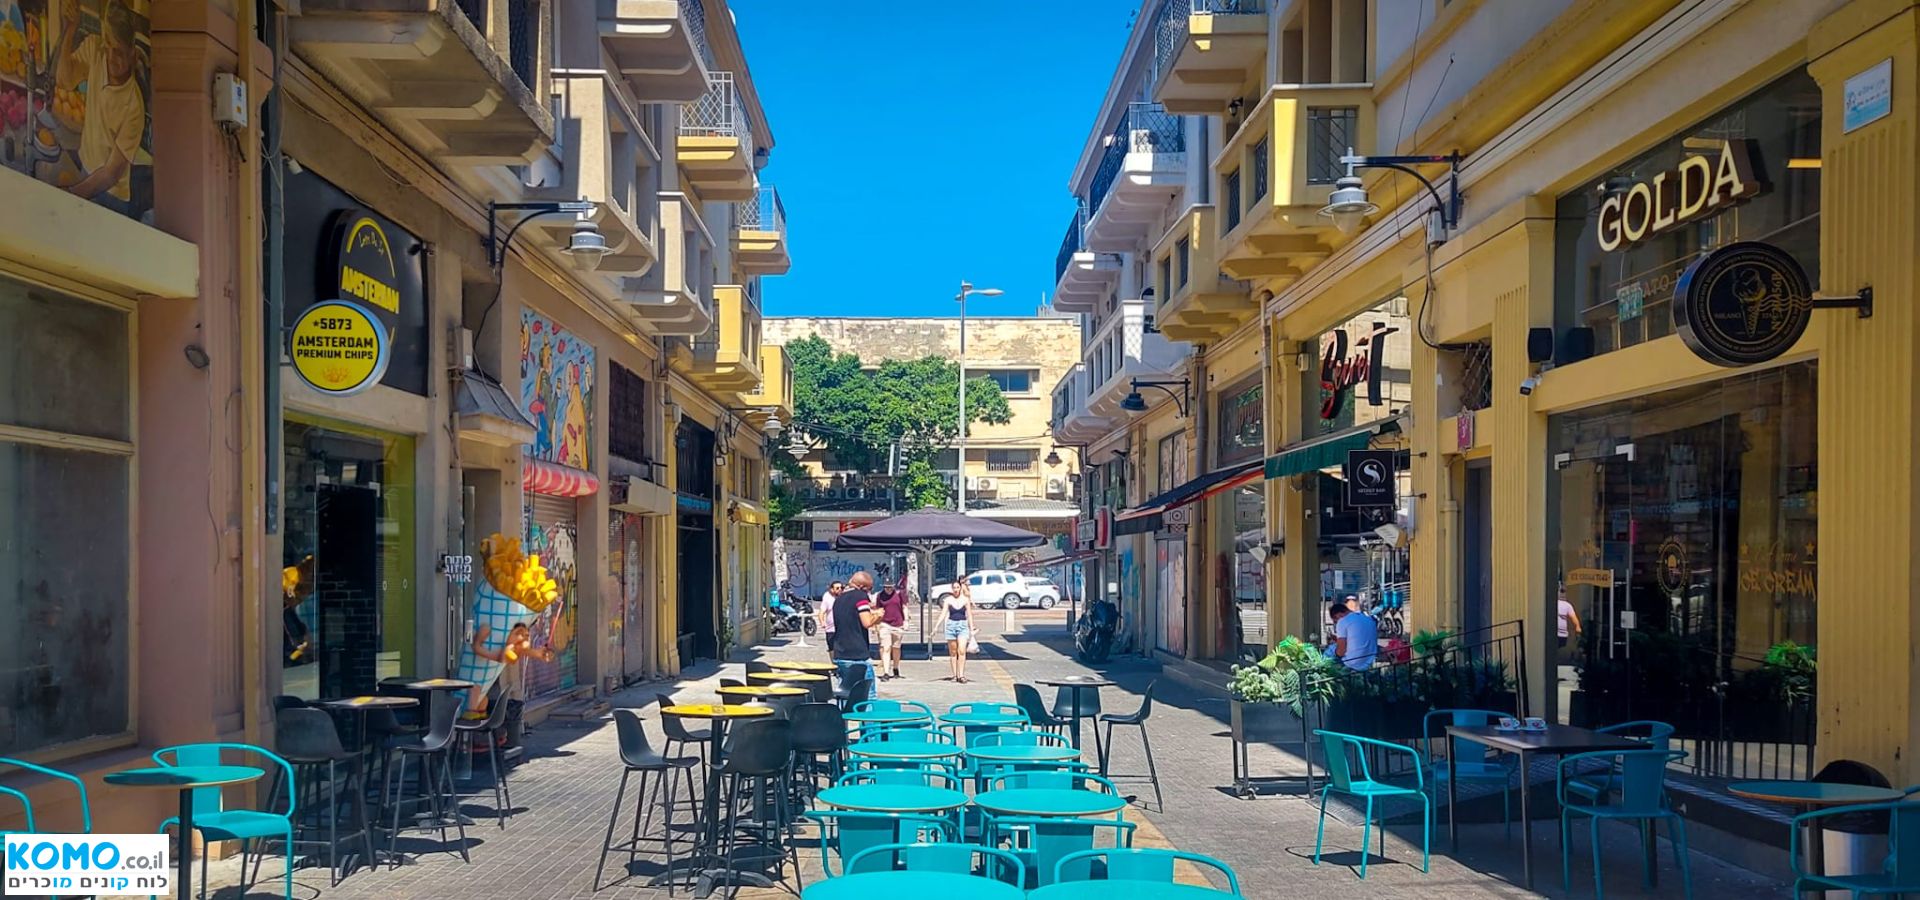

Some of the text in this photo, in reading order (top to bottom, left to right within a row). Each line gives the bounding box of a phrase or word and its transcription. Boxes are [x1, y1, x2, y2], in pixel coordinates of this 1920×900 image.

[1598, 139, 1744, 251] GOLDA
[341, 265, 399, 314] AMSTERDAM
[297, 336, 374, 349] AMSTERDAM
[297, 349, 374, 360] PREMIUM CHIPS
[445, 555, 472, 565] פתוח
